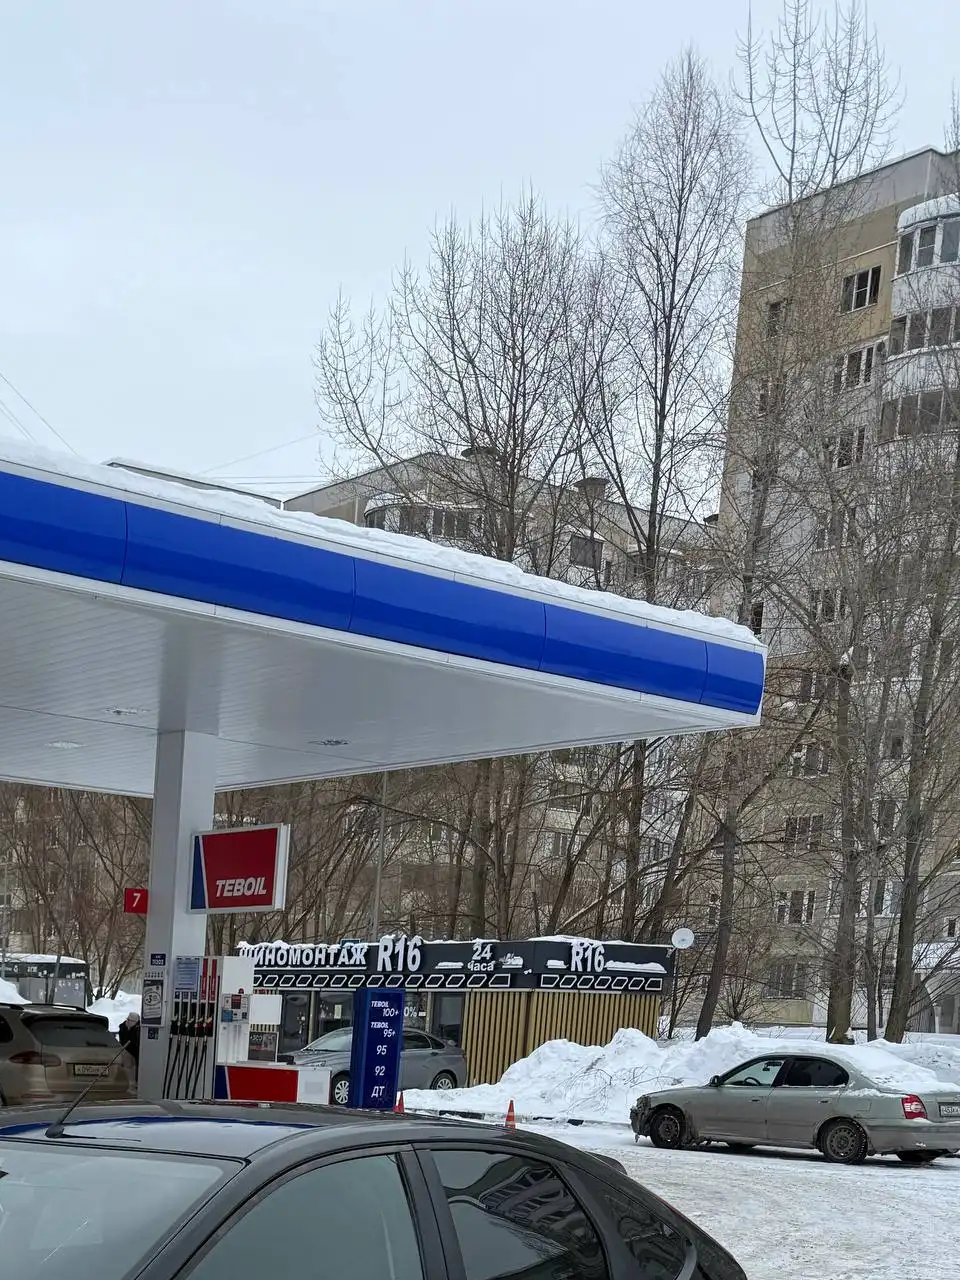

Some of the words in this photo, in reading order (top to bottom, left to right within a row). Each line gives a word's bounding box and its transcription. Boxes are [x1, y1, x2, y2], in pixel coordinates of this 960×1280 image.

[215, 876, 268, 898] TEBOIL
[132, 892, 142, 908] 7
[377, 935, 423, 972] R16
[471, 941, 493, 960] 24
[570, 940, 605, 973] R16
[382, 1007, 399, 1017] 100+
[383, 1028, 396, 1038] 95+
[376, 1044, 388, 1055] 95
[374, 1065, 386, 1076] 92
[371, 1085, 385, 1098] ДТ
